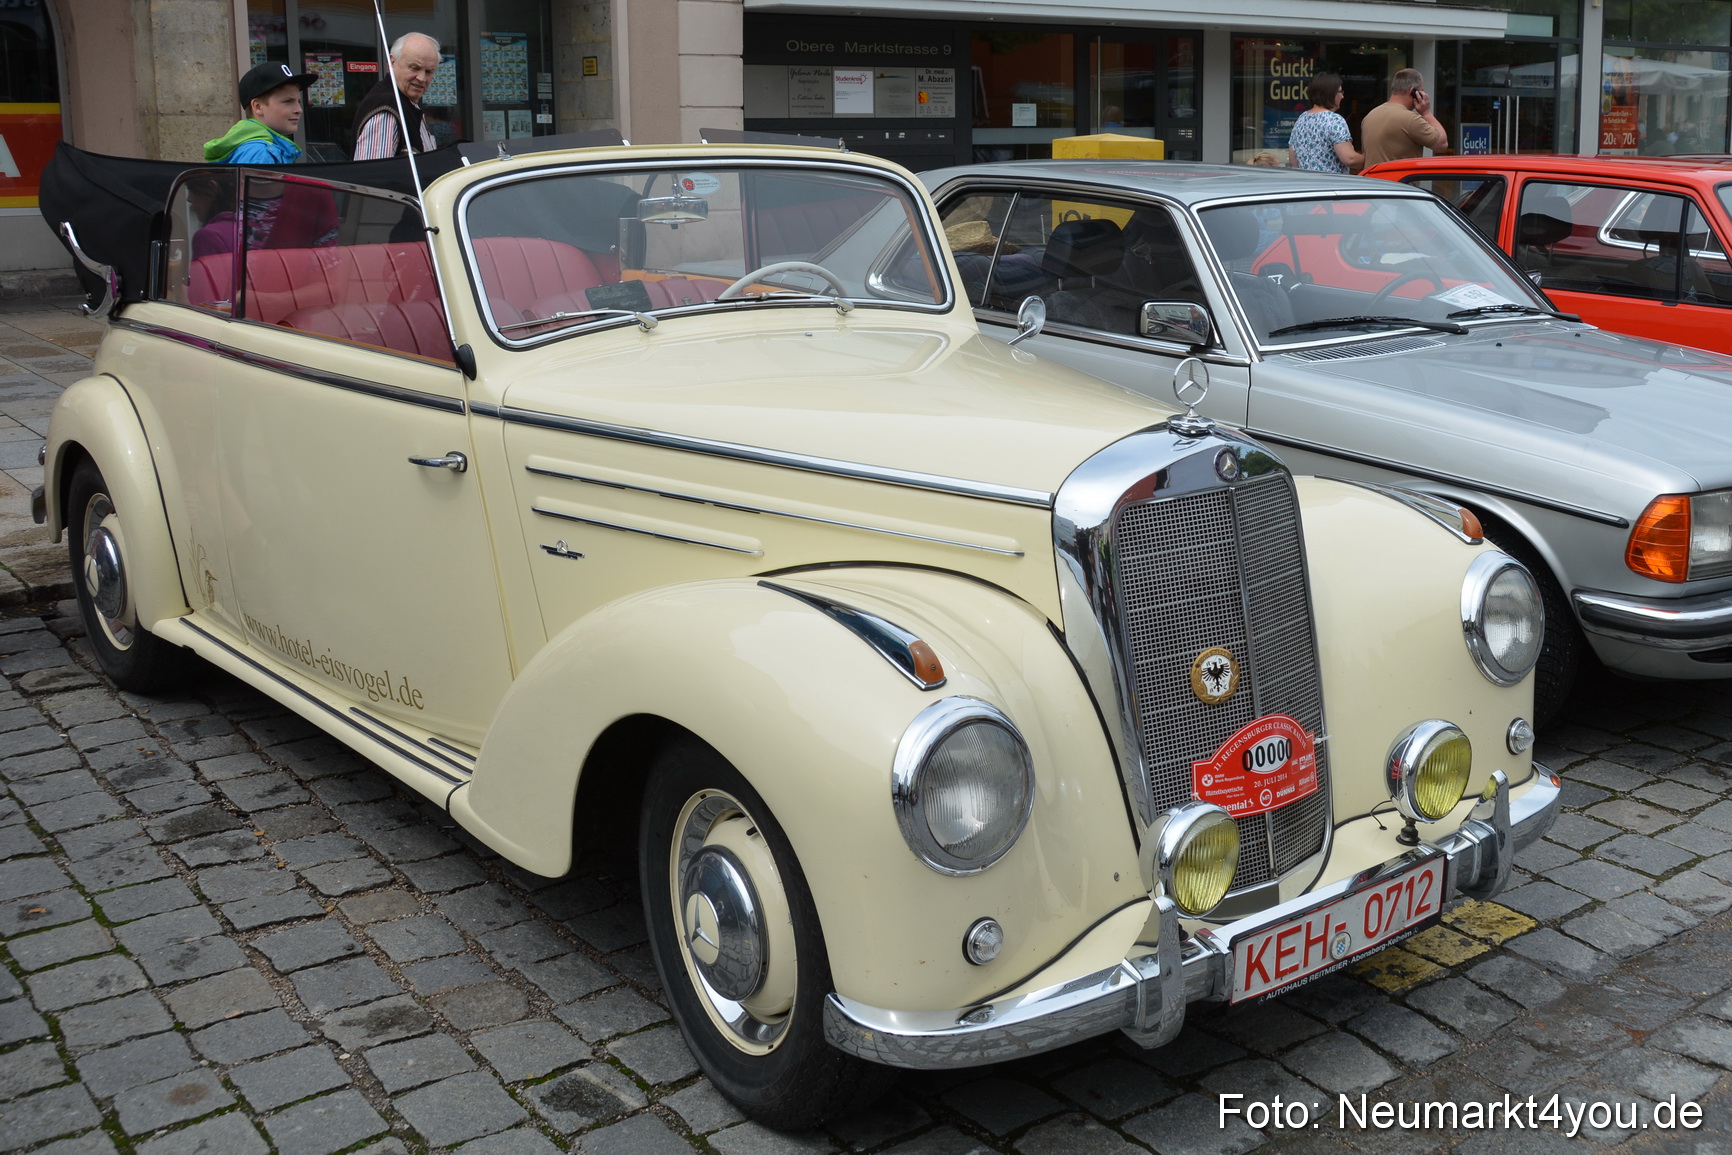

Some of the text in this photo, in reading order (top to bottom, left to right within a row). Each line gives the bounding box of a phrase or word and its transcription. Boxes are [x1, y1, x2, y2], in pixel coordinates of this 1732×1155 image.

[787, 40, 952, 55] Obere Marktstrasse 9
[350, 63, 376, 72] Eingang
[1270, 57, 1314, 77] Guck!
[1463, 137, 1487, 149] Guck!
[244, 613, 424, 710] www.hotel-eisvogel.de
[1213, 762, 1224, 771] 11.
[1221, 722, 1273, 761] REGENSBURGER
[1273, 721, 1294, 733] CLASSIC
[1263, 776, 1276, 787] JULI
[1363, 869, 1434, 940] 0712
[1265, 979, 1308, 1001] AUTOHAUS
[1308, 960, 1348, 981] REITMEIER
